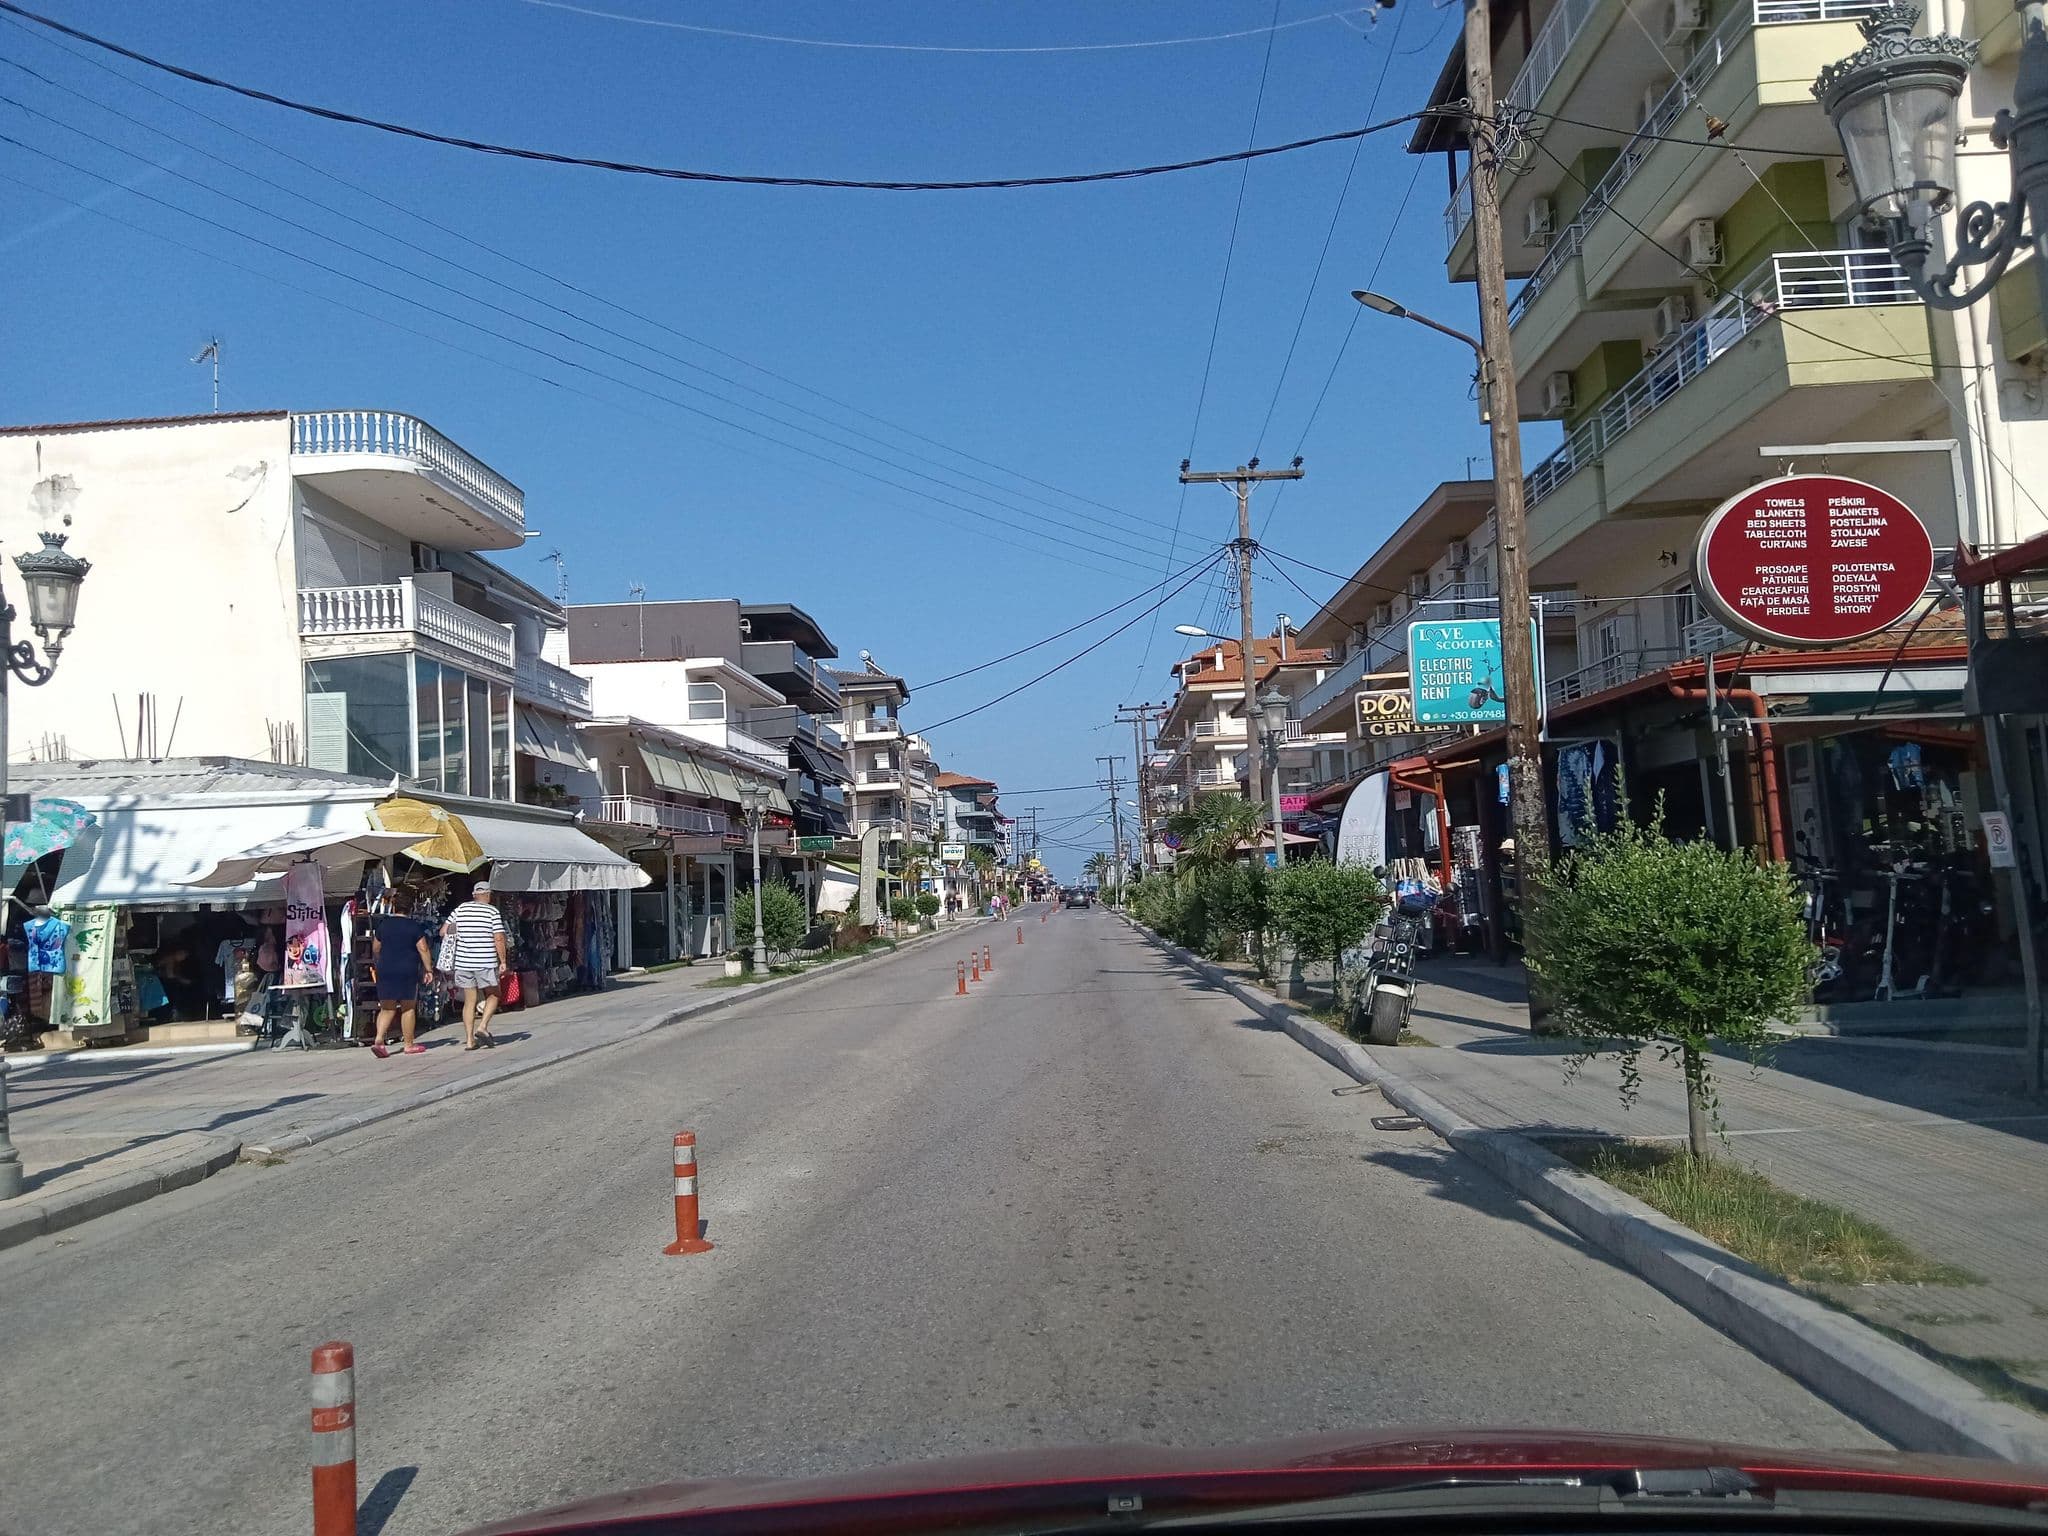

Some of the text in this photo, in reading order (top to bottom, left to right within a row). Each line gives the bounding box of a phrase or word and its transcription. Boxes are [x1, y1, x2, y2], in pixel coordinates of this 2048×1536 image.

[1765, 499, 1805, 507] TOWELS
[1828, 496, 1866, 506] PEŠKIRI
[1755, 509, 1806, 518] BLANKETS
[1829, 507, 1880, 517] BLANKETS
[1747, 519, 1807, 528] BED SHEETS
[1830, 517, 1888, 527] POSTELJINA
[1744, 529, 1807, 539] TABLECLOTH
[1830, 528, 1881, 538] STOLNJAK
[1760, 540, 1808, 549] CURTAINS
[1831, 538, 1868, 548] ZAVESE
[1755, 565, 1809, 574] PROSOAPE
[1832, 563, 1896, 572] POLOTENTSA
[1832, 573, 1878, 583] ODEYALA
[1741, 585, 1809, 596] CEARCEAFURI
[1833, 583, 1881, 593] PROSTYNI
[1767, 597, 1781, 606] DE
[1766, 606, 1811, 616] PERDELE
[1834, 604, 1872, 614] SHTORY
[1436, 639, 1494, 650] SCOOTER
[1420, 658, 1473, 672] ELECTRIC
[1421, 672, 1473, 686] SCOOTER
[1421, 686, 1452, 700] RENT
[1449, 711, 1468, 720] +30
[62, 912, 105, 924] GREECE
